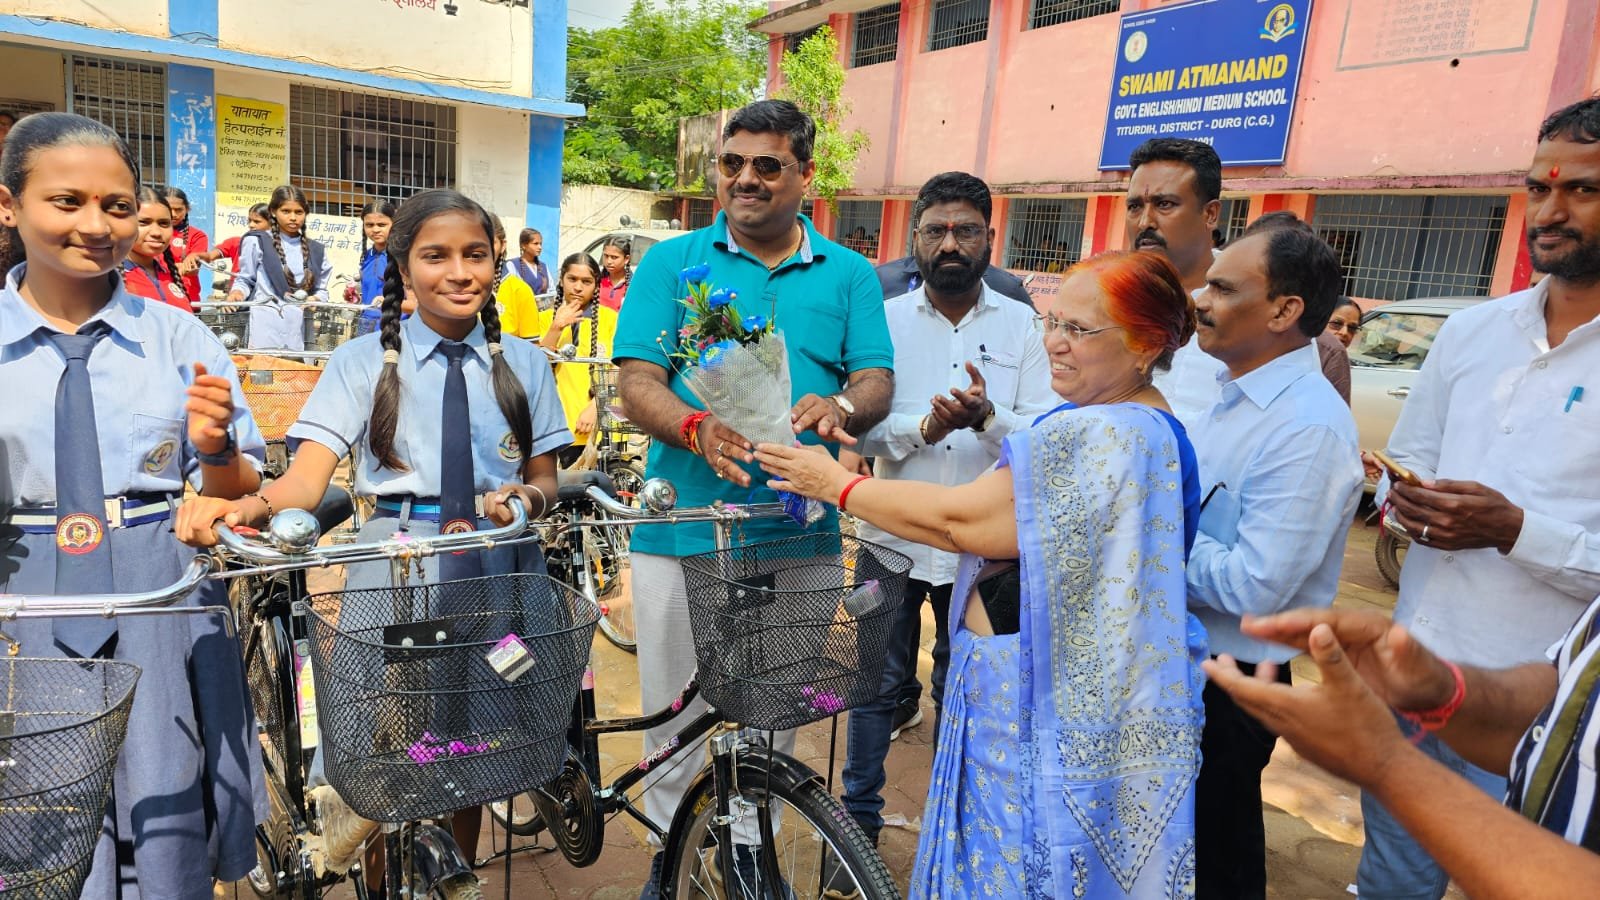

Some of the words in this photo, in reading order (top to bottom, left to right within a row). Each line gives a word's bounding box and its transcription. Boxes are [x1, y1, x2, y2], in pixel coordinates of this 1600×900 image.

[1118, 69, 1175, 98] SWAMI
[1177, 54, 1289, 91] ATMANAND
[231, 105, 273, 121] यातायात
[1114, 103, 1137, 120] GOVT.
[1138, 96, 1202, 118] ENGLISH/HINDI
[1203, 93, 1242, 112] MEDIUM
[1243, 88, 1287, 108] SCHOOL
[1116, 121, 1158, 137] TITURDIH,
[1159, 119, 1203, 133] DISTRICT
[1212, 116, 1242, 130] DURG
[1243, 114, 1275, 130] (C.G.)
